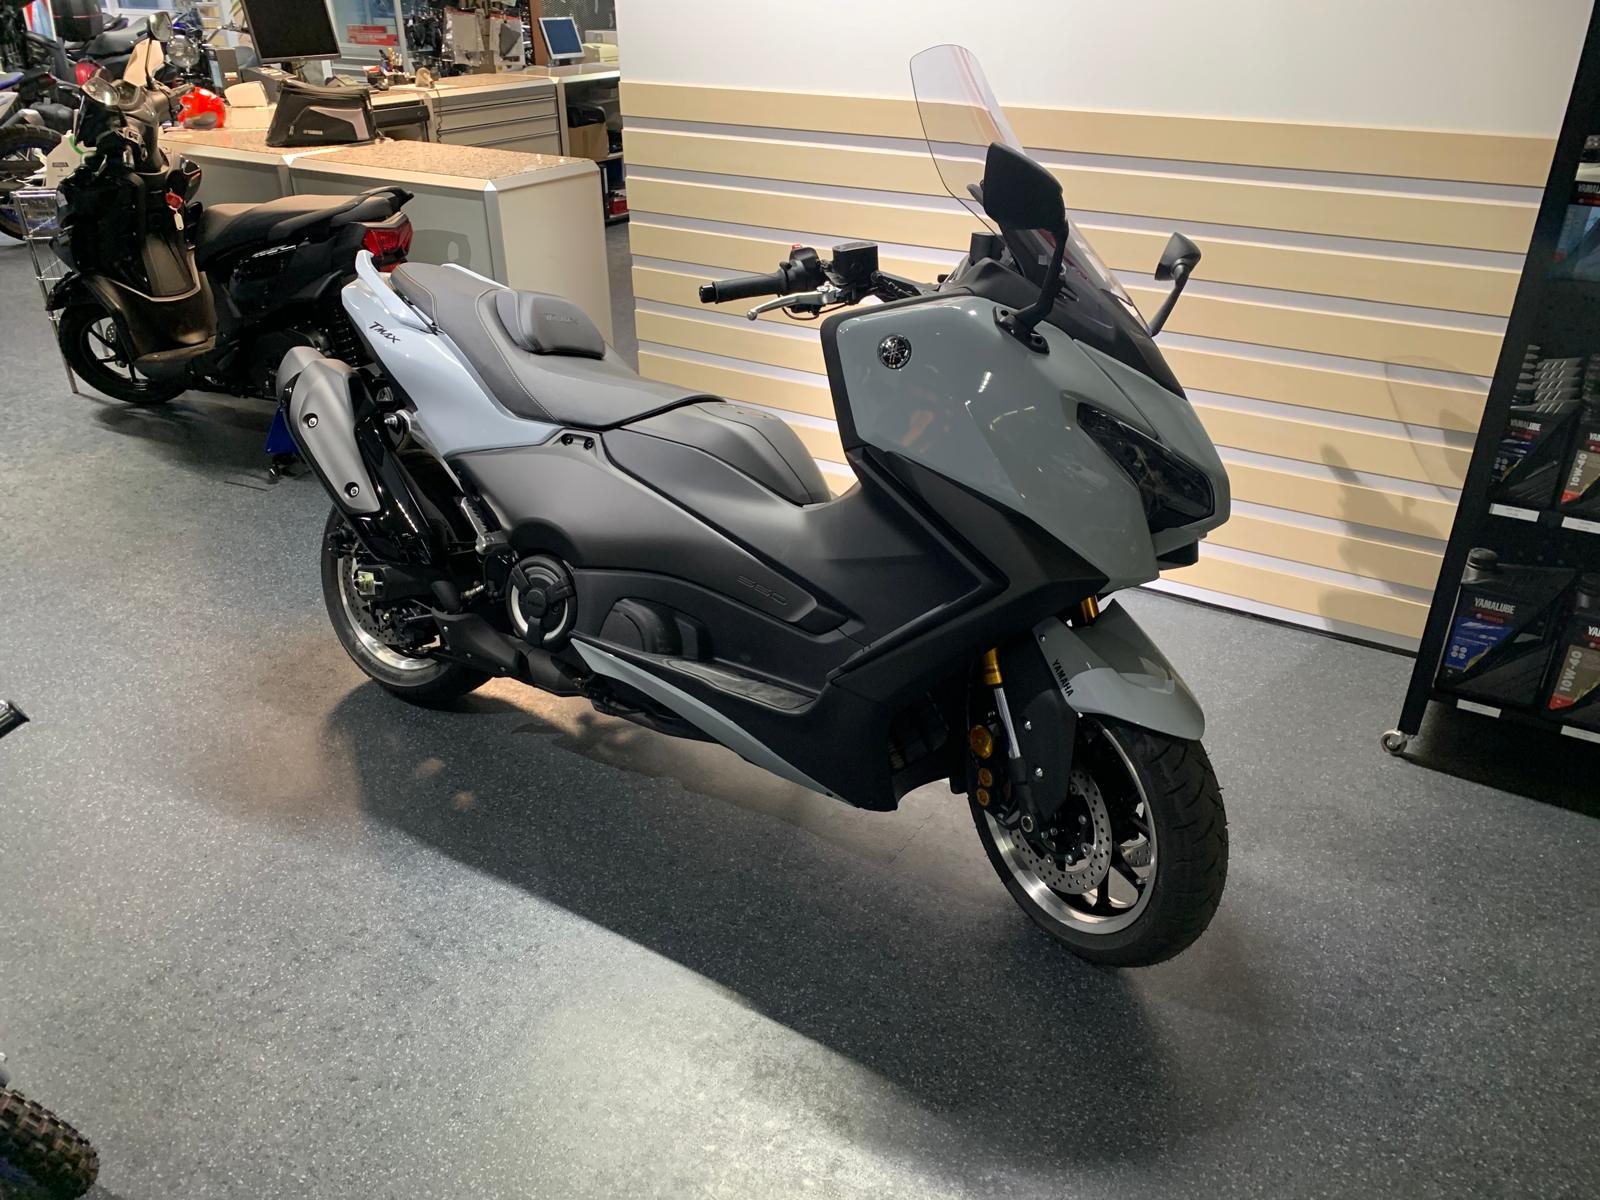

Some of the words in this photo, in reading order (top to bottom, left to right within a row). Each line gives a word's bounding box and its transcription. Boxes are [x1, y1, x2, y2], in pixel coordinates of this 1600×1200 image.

[1570, 453, 1588, 486] 10W-40
[1474, 597, 1516, 614] YAMALUBE
[1052, 657, 1074, 697] YAMAHA
[1560, 650, 1582, 692] 10W-40
